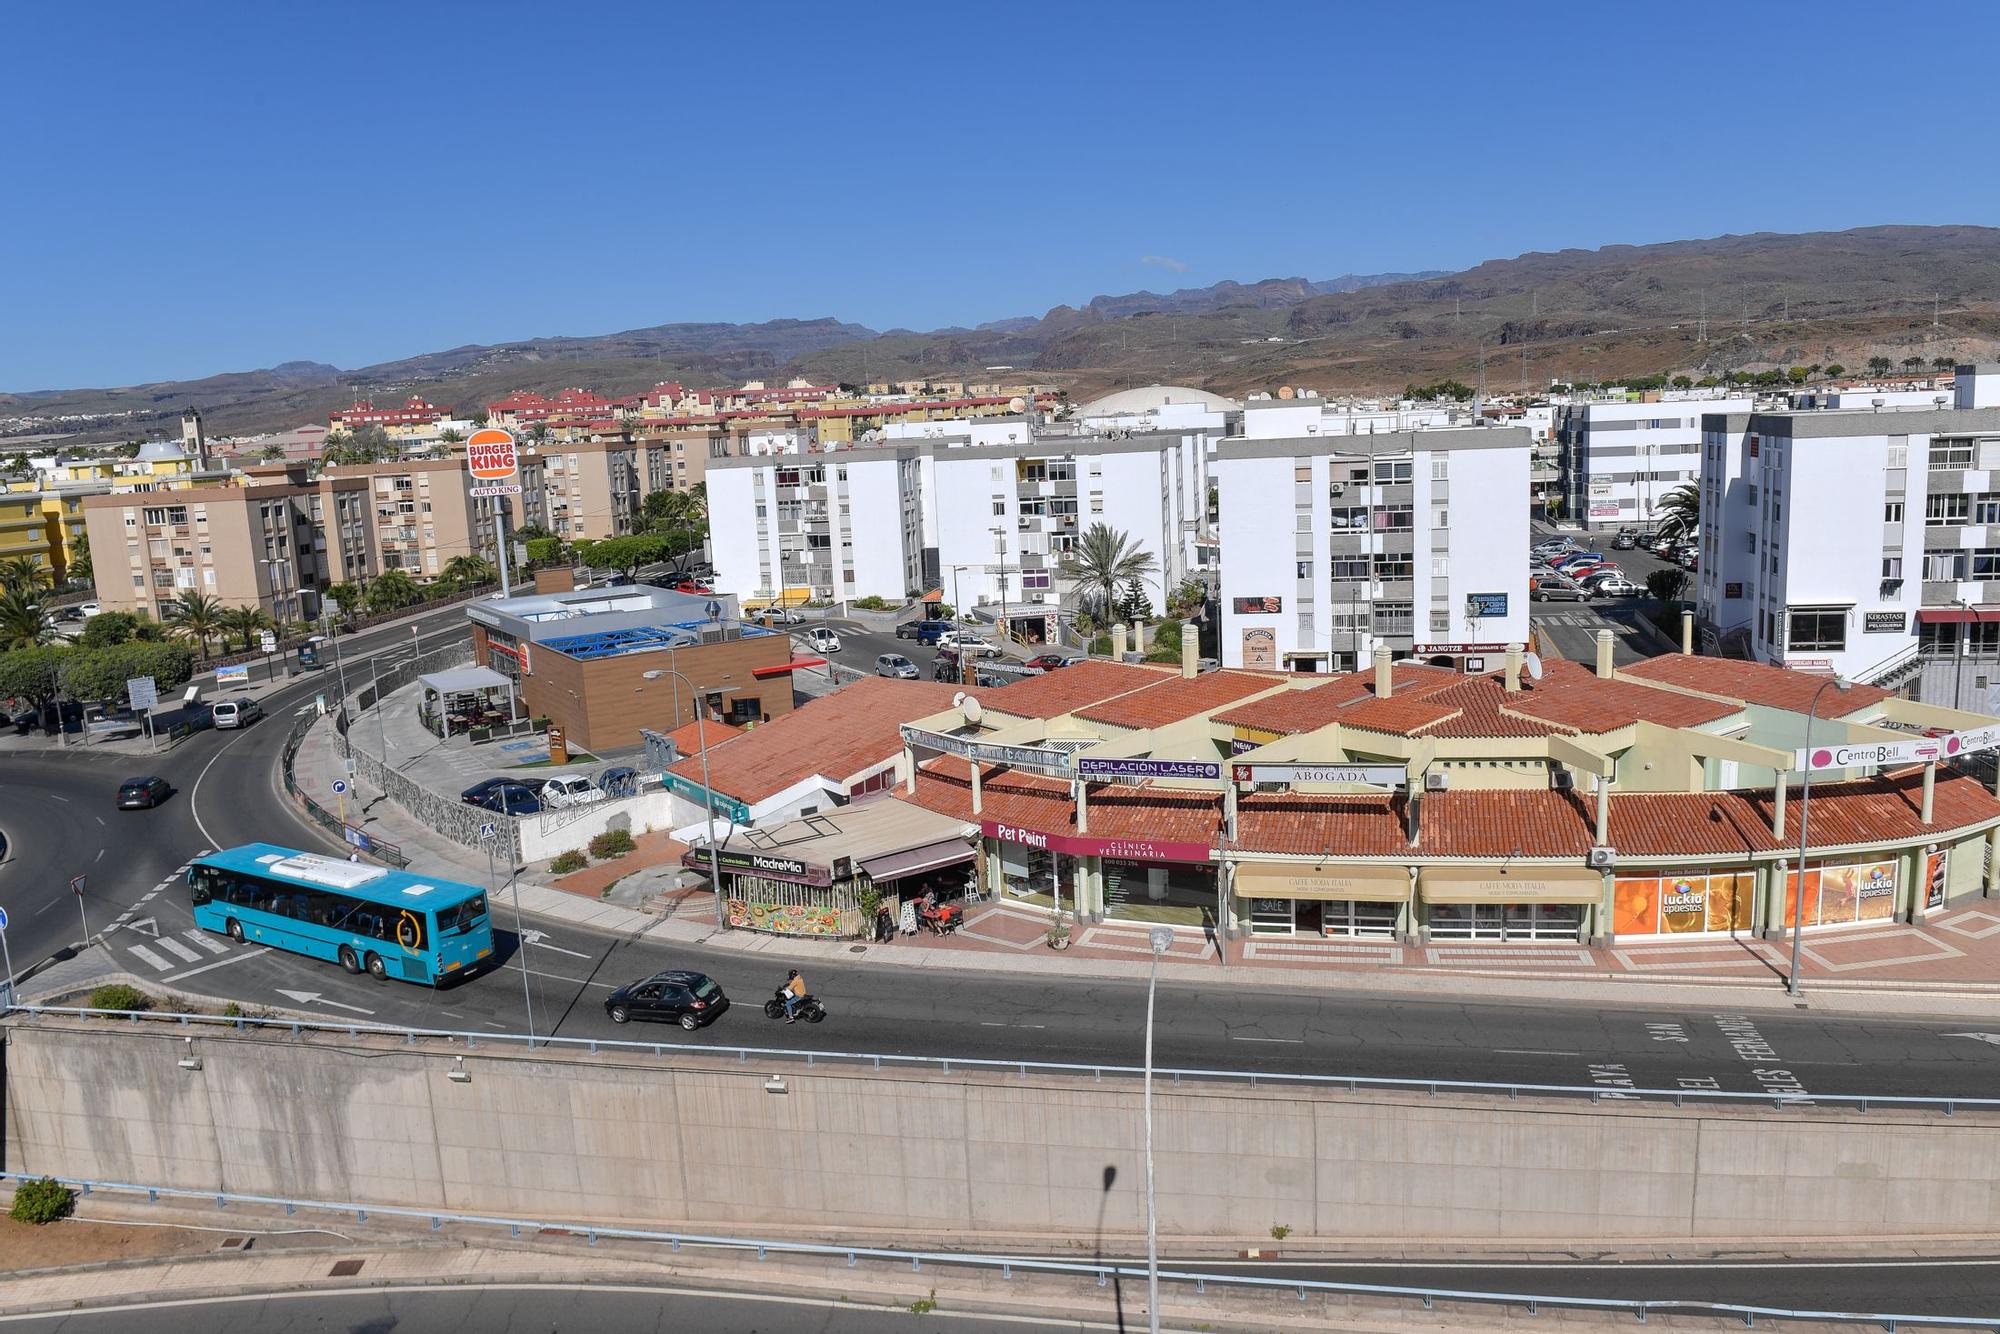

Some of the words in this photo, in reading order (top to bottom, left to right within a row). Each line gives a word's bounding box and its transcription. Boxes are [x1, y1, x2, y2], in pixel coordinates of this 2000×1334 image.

[469, 444, 513, 456] BURGER
[470, 453, 515, 470] KING
[474, 487, 497, 496] AUTO
[498, 485, 519, 494] KING
[1233, 741, 1251, 751] NEW
[1960, 731, 1996, 751] CentroBell
[1836, 746, 1899, 766] CentroBell
[1081, 761, 1157, 772] DEPILACIÓN
[1160, 762, 1205, 774] LÁSER
[1293, 771, 1368, 781] ABOGADA
[997, 824, 1016, 841] Pet
[1018, 827, 1048, 849] Point
[1110, 840, 1153, 850] CLÍNICA
[1099, 848, 1166, 858] VETERINARIA
[753, 855, 802, 873] MadreMia
[1860, 878, 1893, 891] luckia
[1663, 893, 1703, 905] luckia
[1859, 888, 1893, 899] apuestas
[1261, 900, 1284, 911] SALE
[1663, 904, 1703, 915] apuestas
[1644, 1022, 1689, 1043] SAN
[1713, 1014, 1781, 1062] FERNANDO
